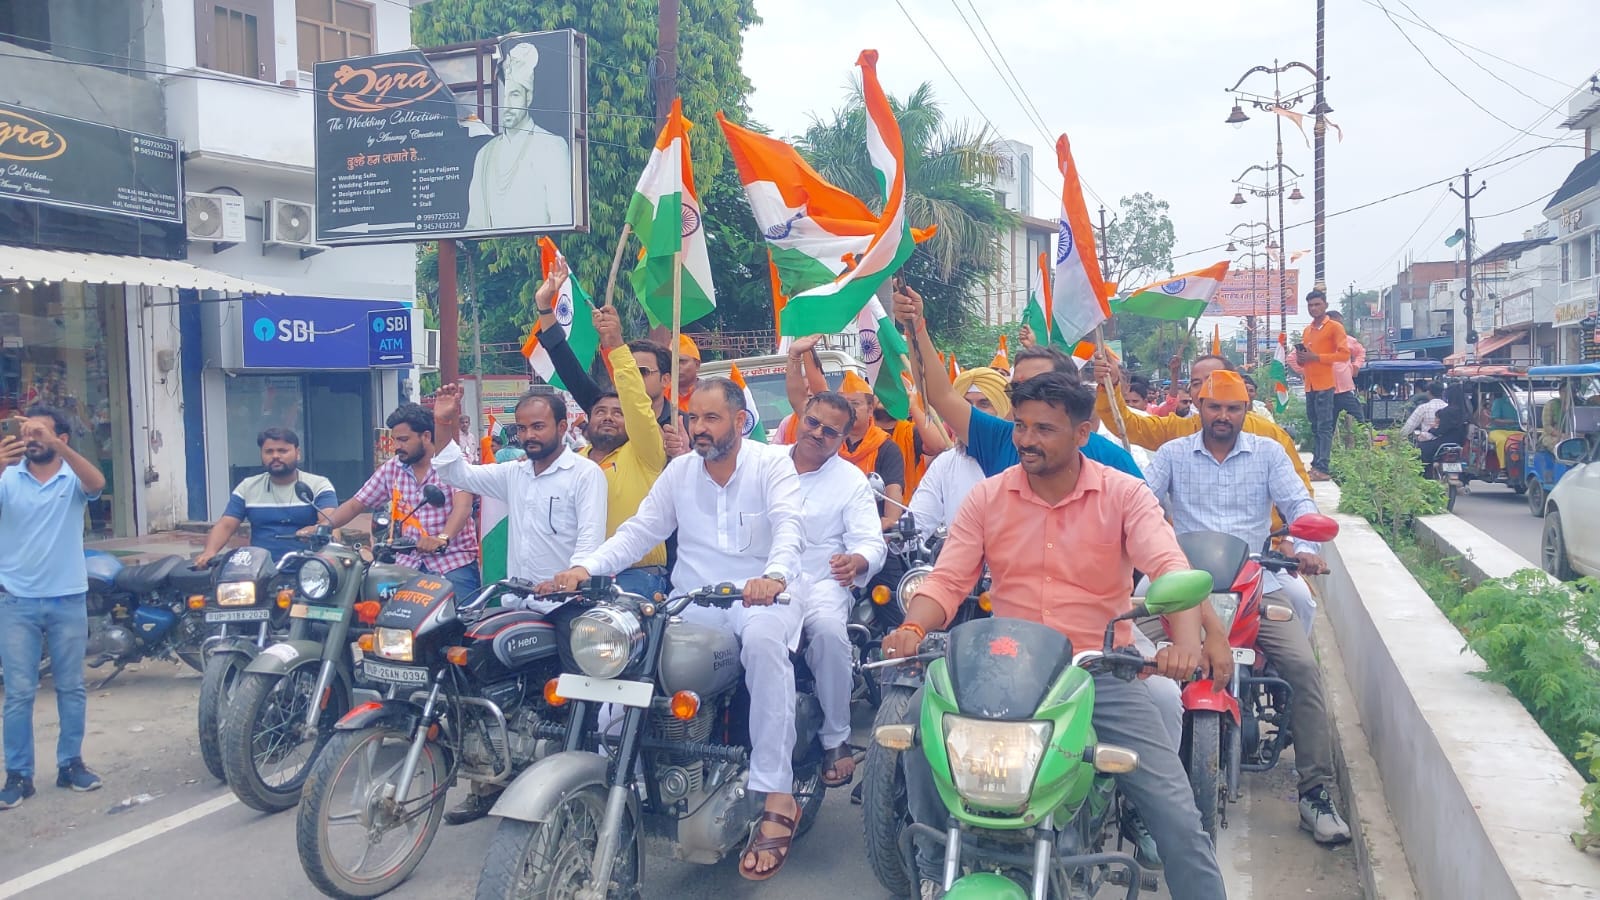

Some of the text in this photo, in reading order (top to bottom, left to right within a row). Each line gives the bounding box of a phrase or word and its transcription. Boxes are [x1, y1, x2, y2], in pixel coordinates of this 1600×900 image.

[326, 117, 343, 132] The
[345, 115, 387, 130] Wedding
[367, 155, 380, 165] हम
[383, 149, 408, 163] सजाते
[338, 174, 362, 182] Wedding
[419, 175, 444, 183] Designer
[338, 182, 362, 190] Wedding
[338, 189, 362, 198] Designer
[386, 316, 408, 332] SBI
[278, 319, 315, 343] SBI
[379, 338, 403, 351] ATM
[417, 579, 442, 590] BJP
